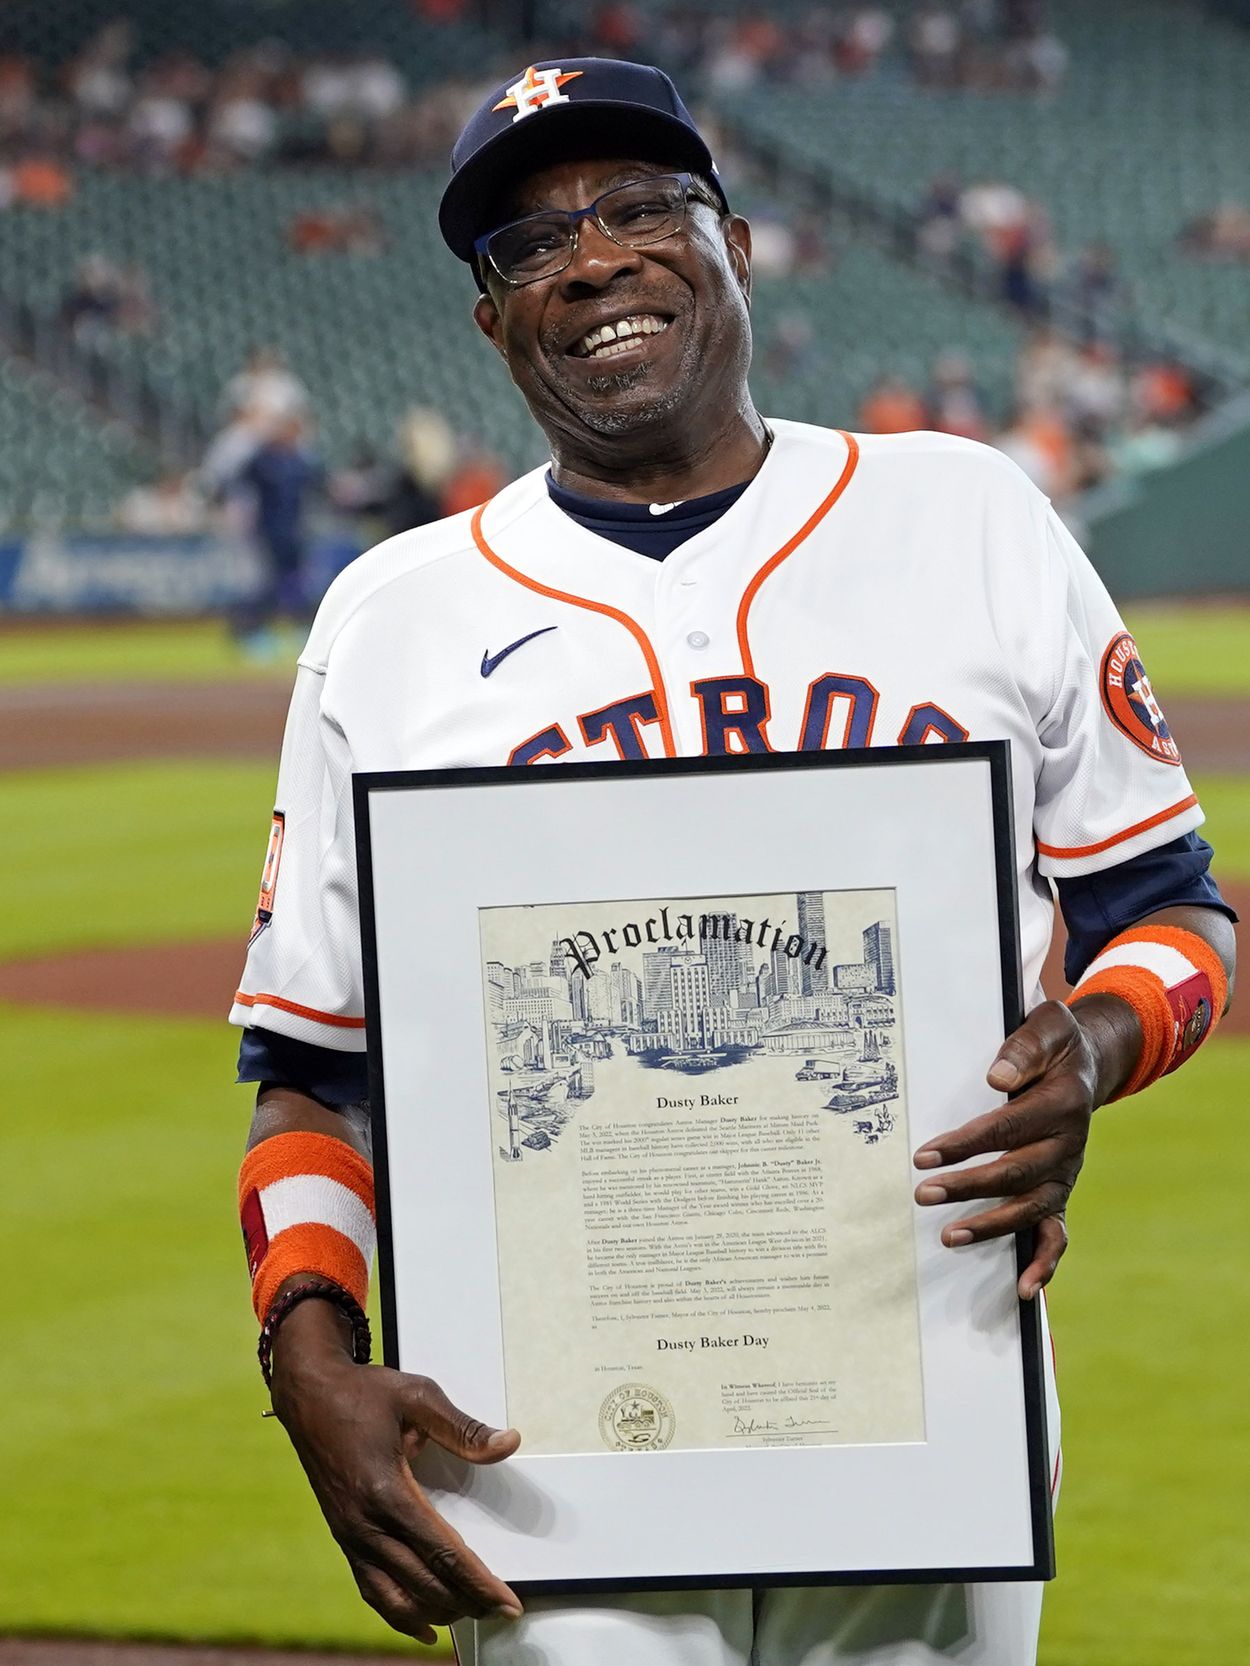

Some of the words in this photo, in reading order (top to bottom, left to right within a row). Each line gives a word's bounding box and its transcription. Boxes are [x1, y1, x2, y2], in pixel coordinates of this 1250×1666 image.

[1108, 638, 1139, 689] HOUST
[559, 906, 829, 980] Proclamation
[656, 1096, 696, 1110] Dusty
[700, 1094, 739, 1106] Baker
[719, 1116, 737, 1124] Dusty
[601, 1237, 618, 1245] Dusty
[684, 1279, 702, 1287] Dusty
[657, 1338, 696, 1352] Dusty
[700, 1336, 740, 1348] Baker
[743, 1334, 770, 1349] Day
